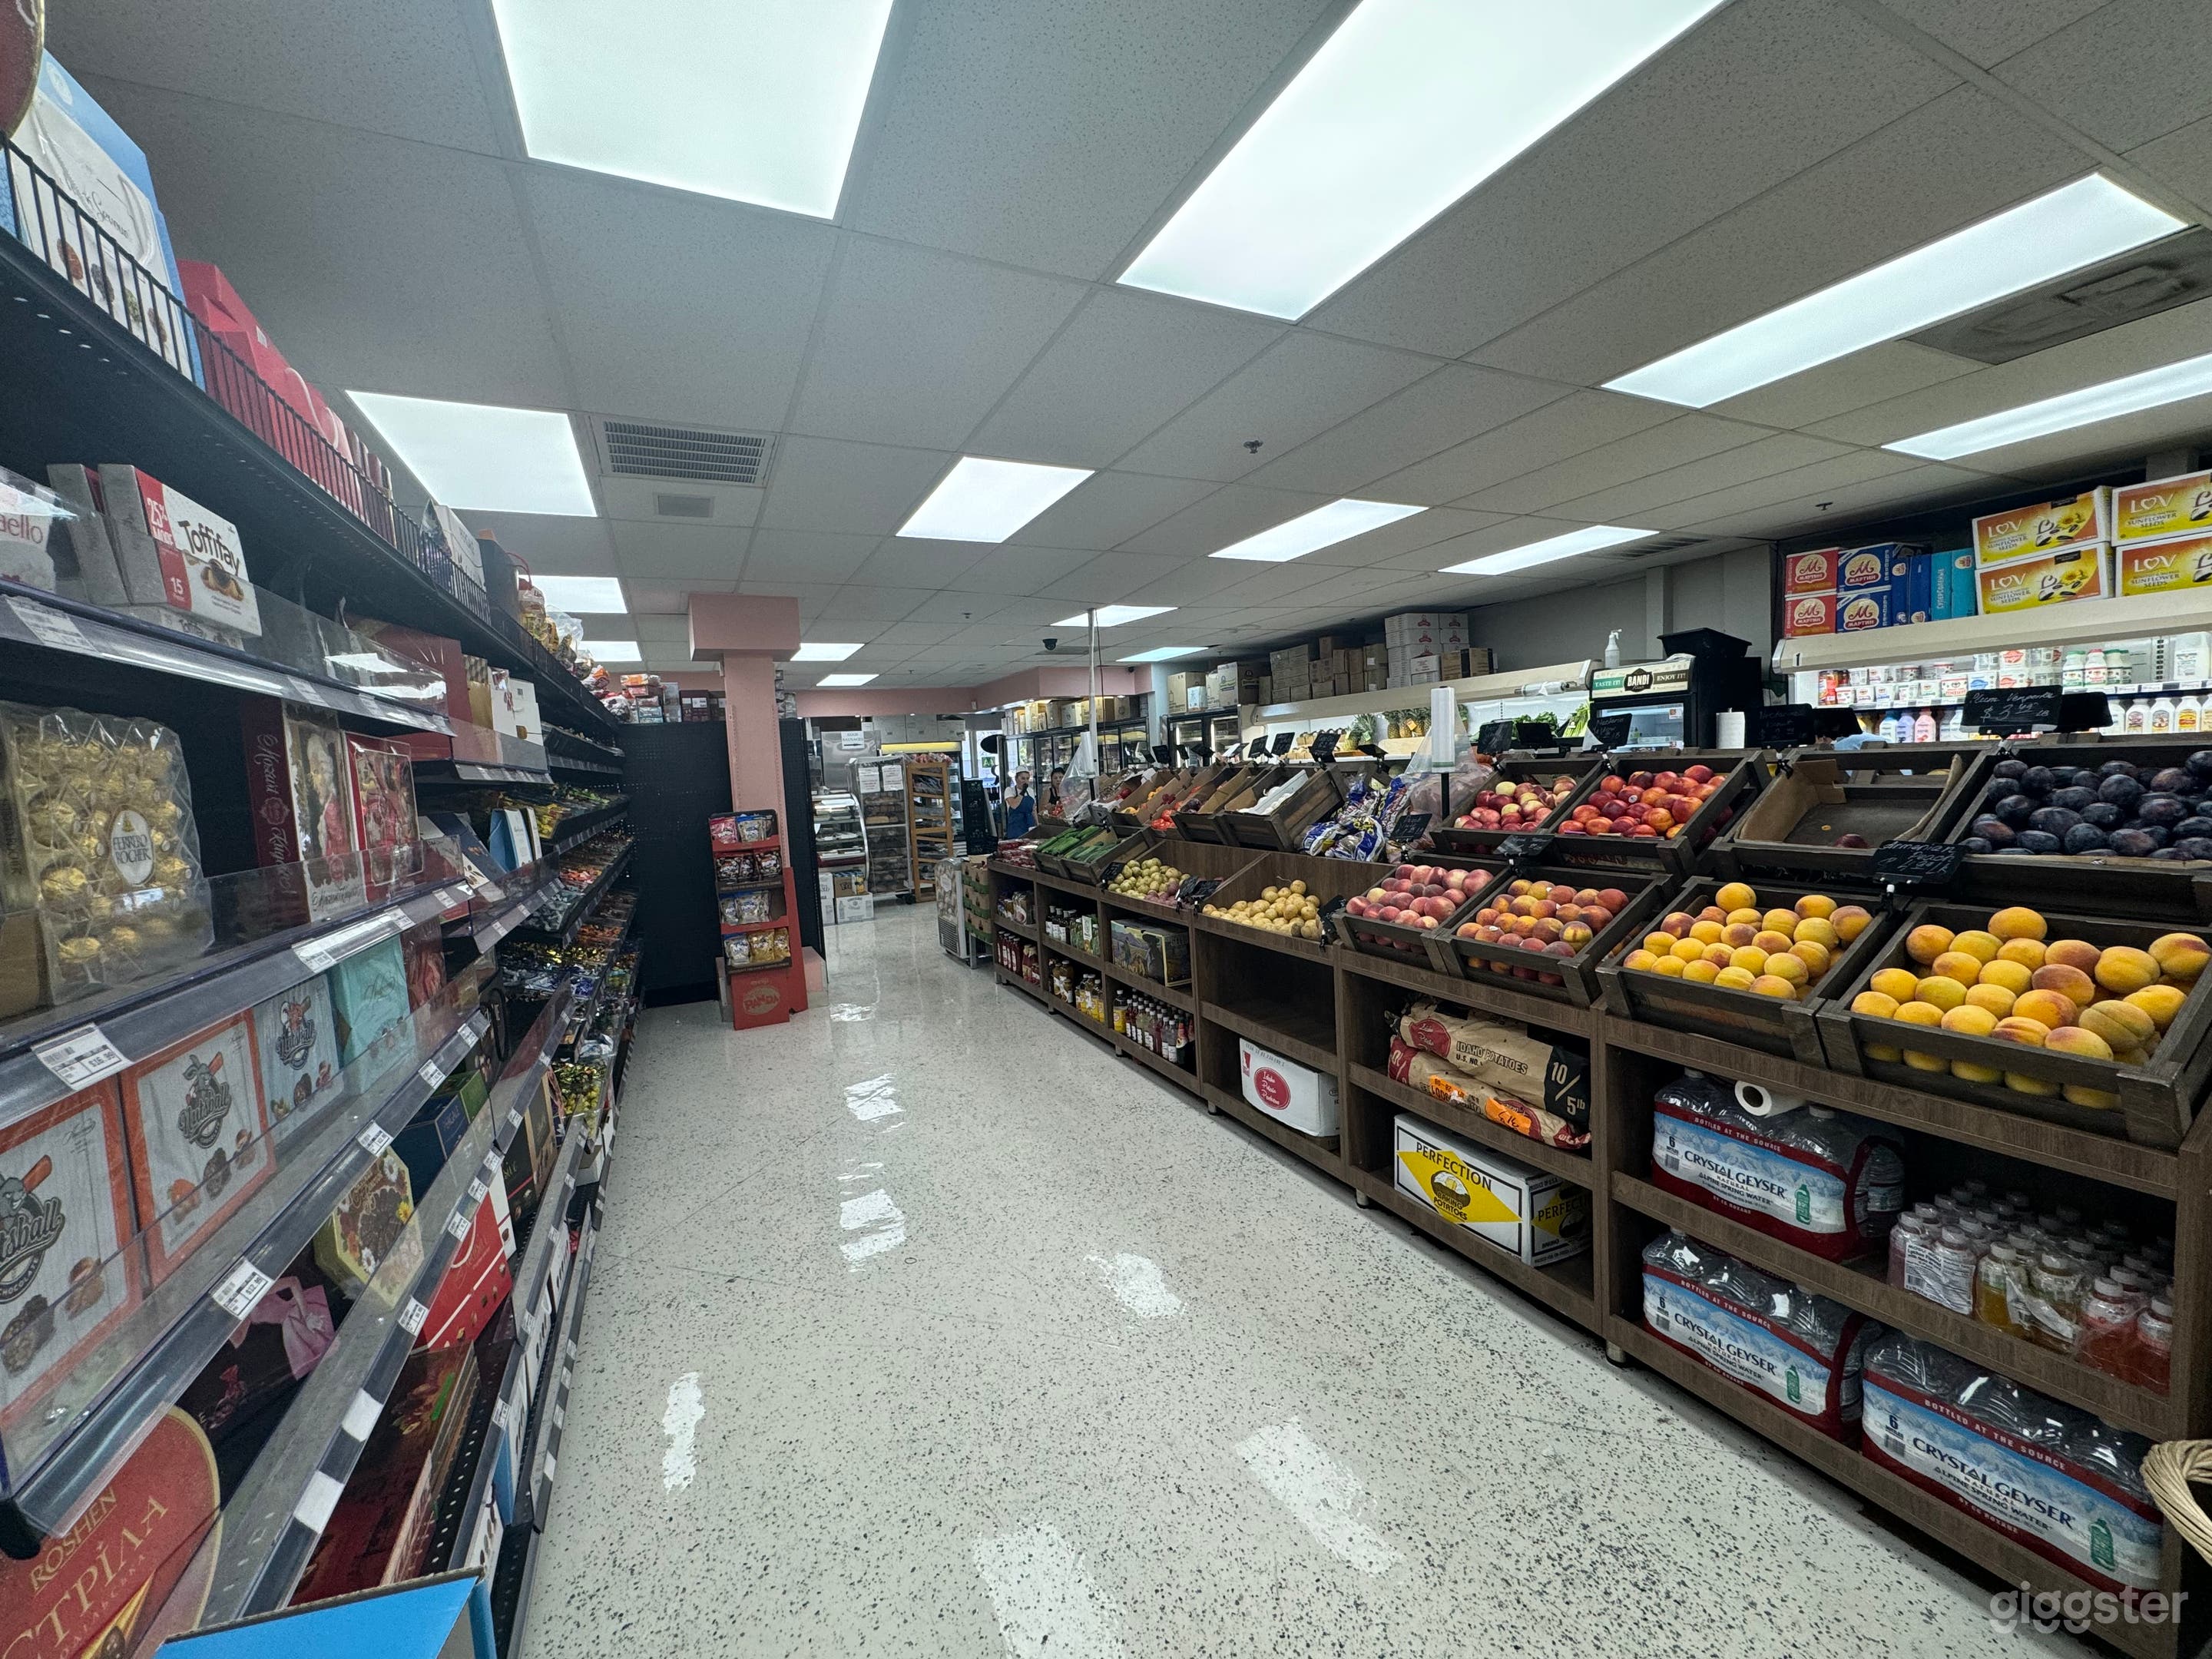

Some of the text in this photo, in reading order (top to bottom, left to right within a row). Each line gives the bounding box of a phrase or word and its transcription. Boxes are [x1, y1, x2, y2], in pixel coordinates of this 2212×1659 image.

[2128, 512, 2177, 526] SUNFLOWER
[177, 520, 240, 576] Toffifay
[1987, 535, 2028, 548] SUNFLOWER
[171, 577, 184, 594] 15
[1849, 575, 1876, 584] МАРТИН
[2131, 573, 2180, 586] SUNFLOWER
[1989, 589, 2032, 602] SUNFLOWER
[1847, 619, 1875, 628] МАРТИН
[1628, 674, 1650, 687] BANDI
[113, 834, 147, 850] FERRERO
[115, 847, 151, 864] ROCHER
[743, 992, 780, 1012] PANDA
[1455, 1041, 1528, 1075] IDAHO POTATOES
[1455, 1053, 1468, 1063] U.S.
[178, 1081, 232, 1140] Nutsball
[1694, 1117, 1722, 1131] BOTTLED
[1736, 1131, 1750, 1141] THE
[1668, 1136, 1676, 1147] 6
[1416, 1142, 1492, 1191] PERFECTION
[1684, 1150, 1786, 1199] CRYSTAL GEYSER
[1698, 1172, 1771, 1206] ALPINE SPRING WATER
[1716, 1174, 1750, 1191] NATURAL
[1433, 1197, 1468, 1221] POTATOES
[1437, 1191, 1463, 1210] BAKING
[0, 1257, 39, 1296] HOCOLATE
[1659, 1296, 1666, 1309] 6
[1681, 1280, 1771, 1330] BOTTLED AT THE SOURCE
[1674, 1313, 1777, 1376] CRYSTAL GEYSER
[1688, 1336, 1763, 1380] ALPINE SPRING WATER
[1889, 1415, 1899, 1430] 6
[1924, 1399, 2066, 1470] BOTTLED AT THE SOURCE
[1912, 1437, 2076, 1530] CRYSTAL GEYSER
[1964, 1476, 2016, 1505] NATURAL
[1934, 1467, 2050, 1530] ALPINE SPRING WATER
[29, 1485, 117, 1591] ROSHEN
